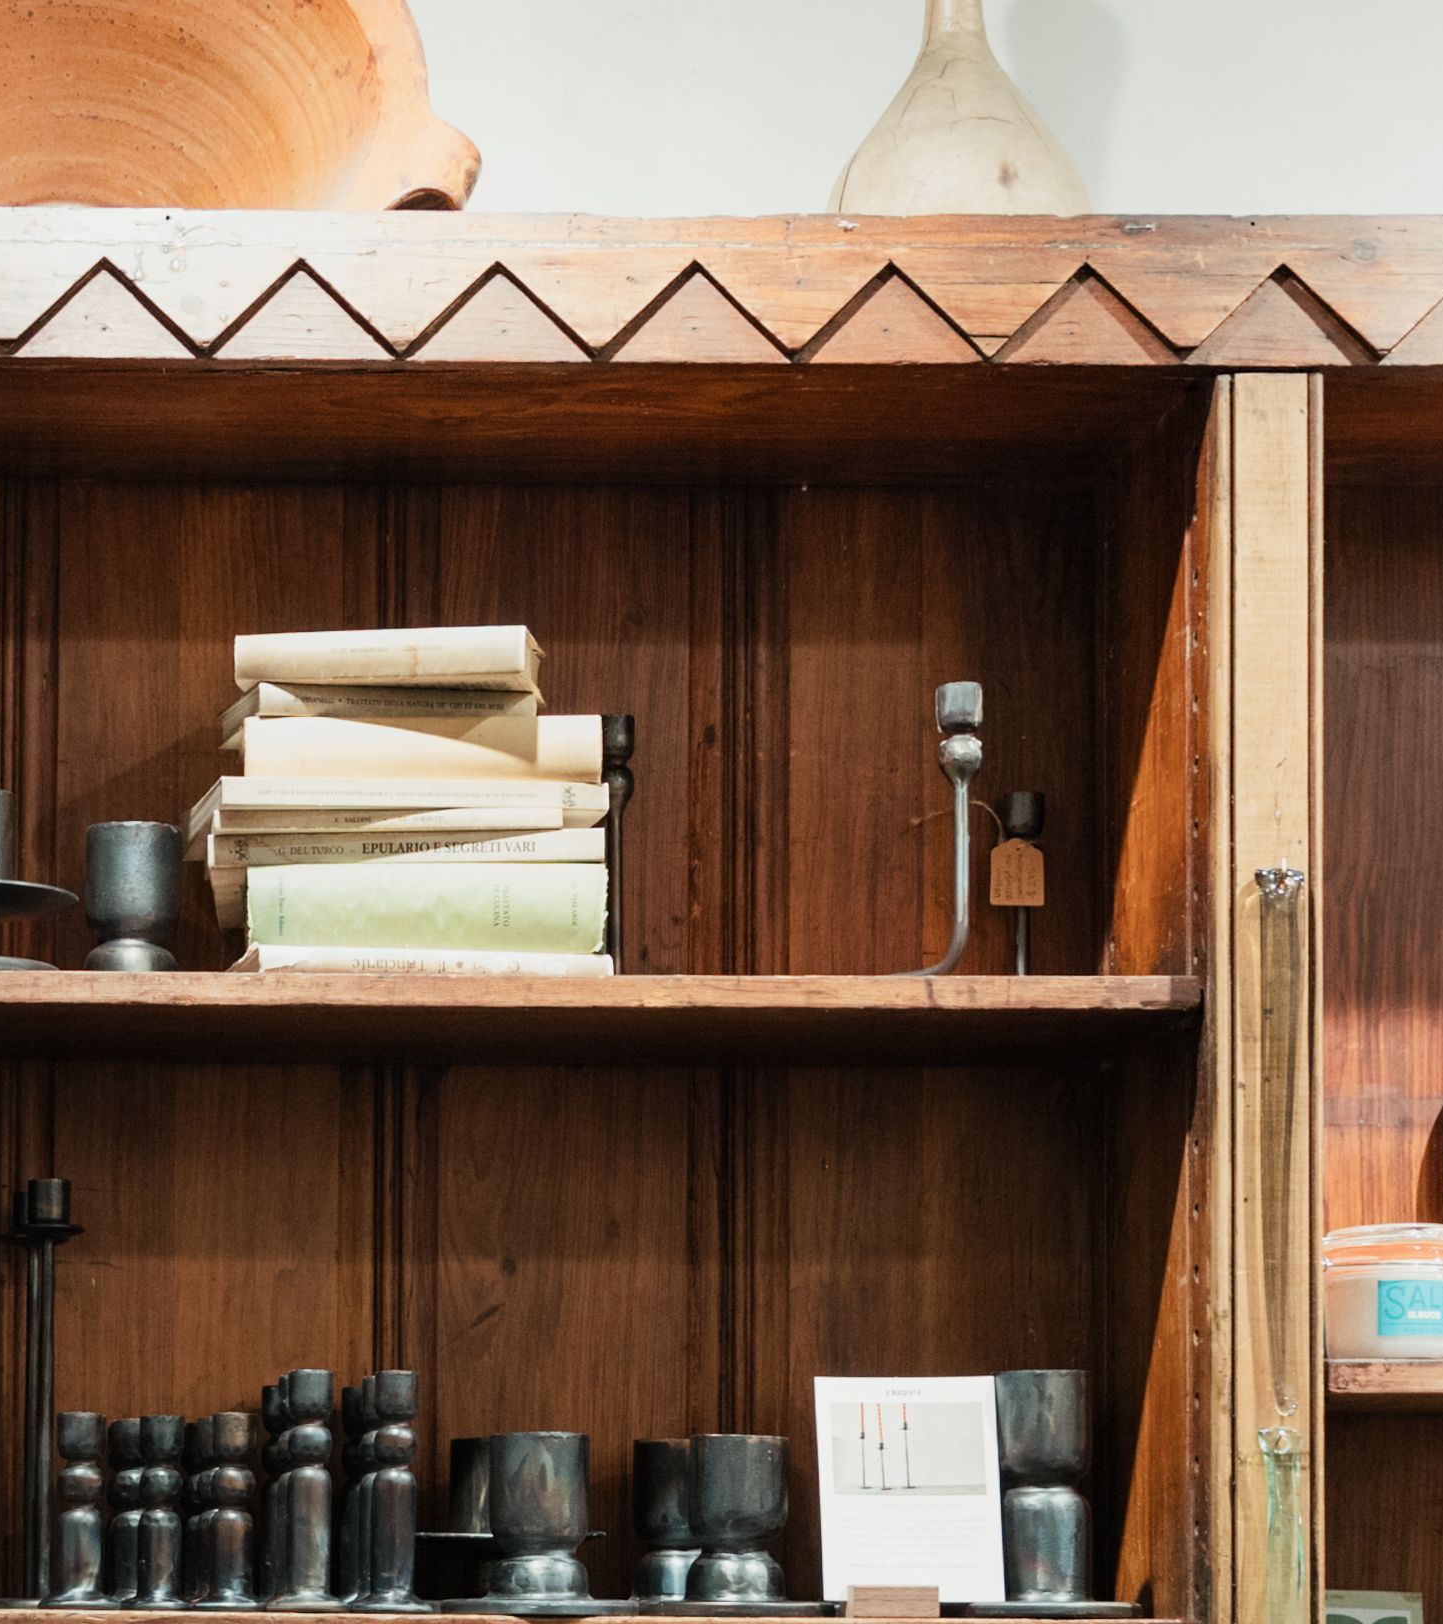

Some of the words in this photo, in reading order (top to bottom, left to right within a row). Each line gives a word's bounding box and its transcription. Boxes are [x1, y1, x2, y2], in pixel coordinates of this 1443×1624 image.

[290, 846, 308, 855] DEL
[310, 846, 345, 855] TURCO
[362, 841, 431, 854] EPULARIO
[433, 841, 442, 854] E
[444, 841, 499, 853] SEGRETI
[503, 841, 536, 853] VARI
